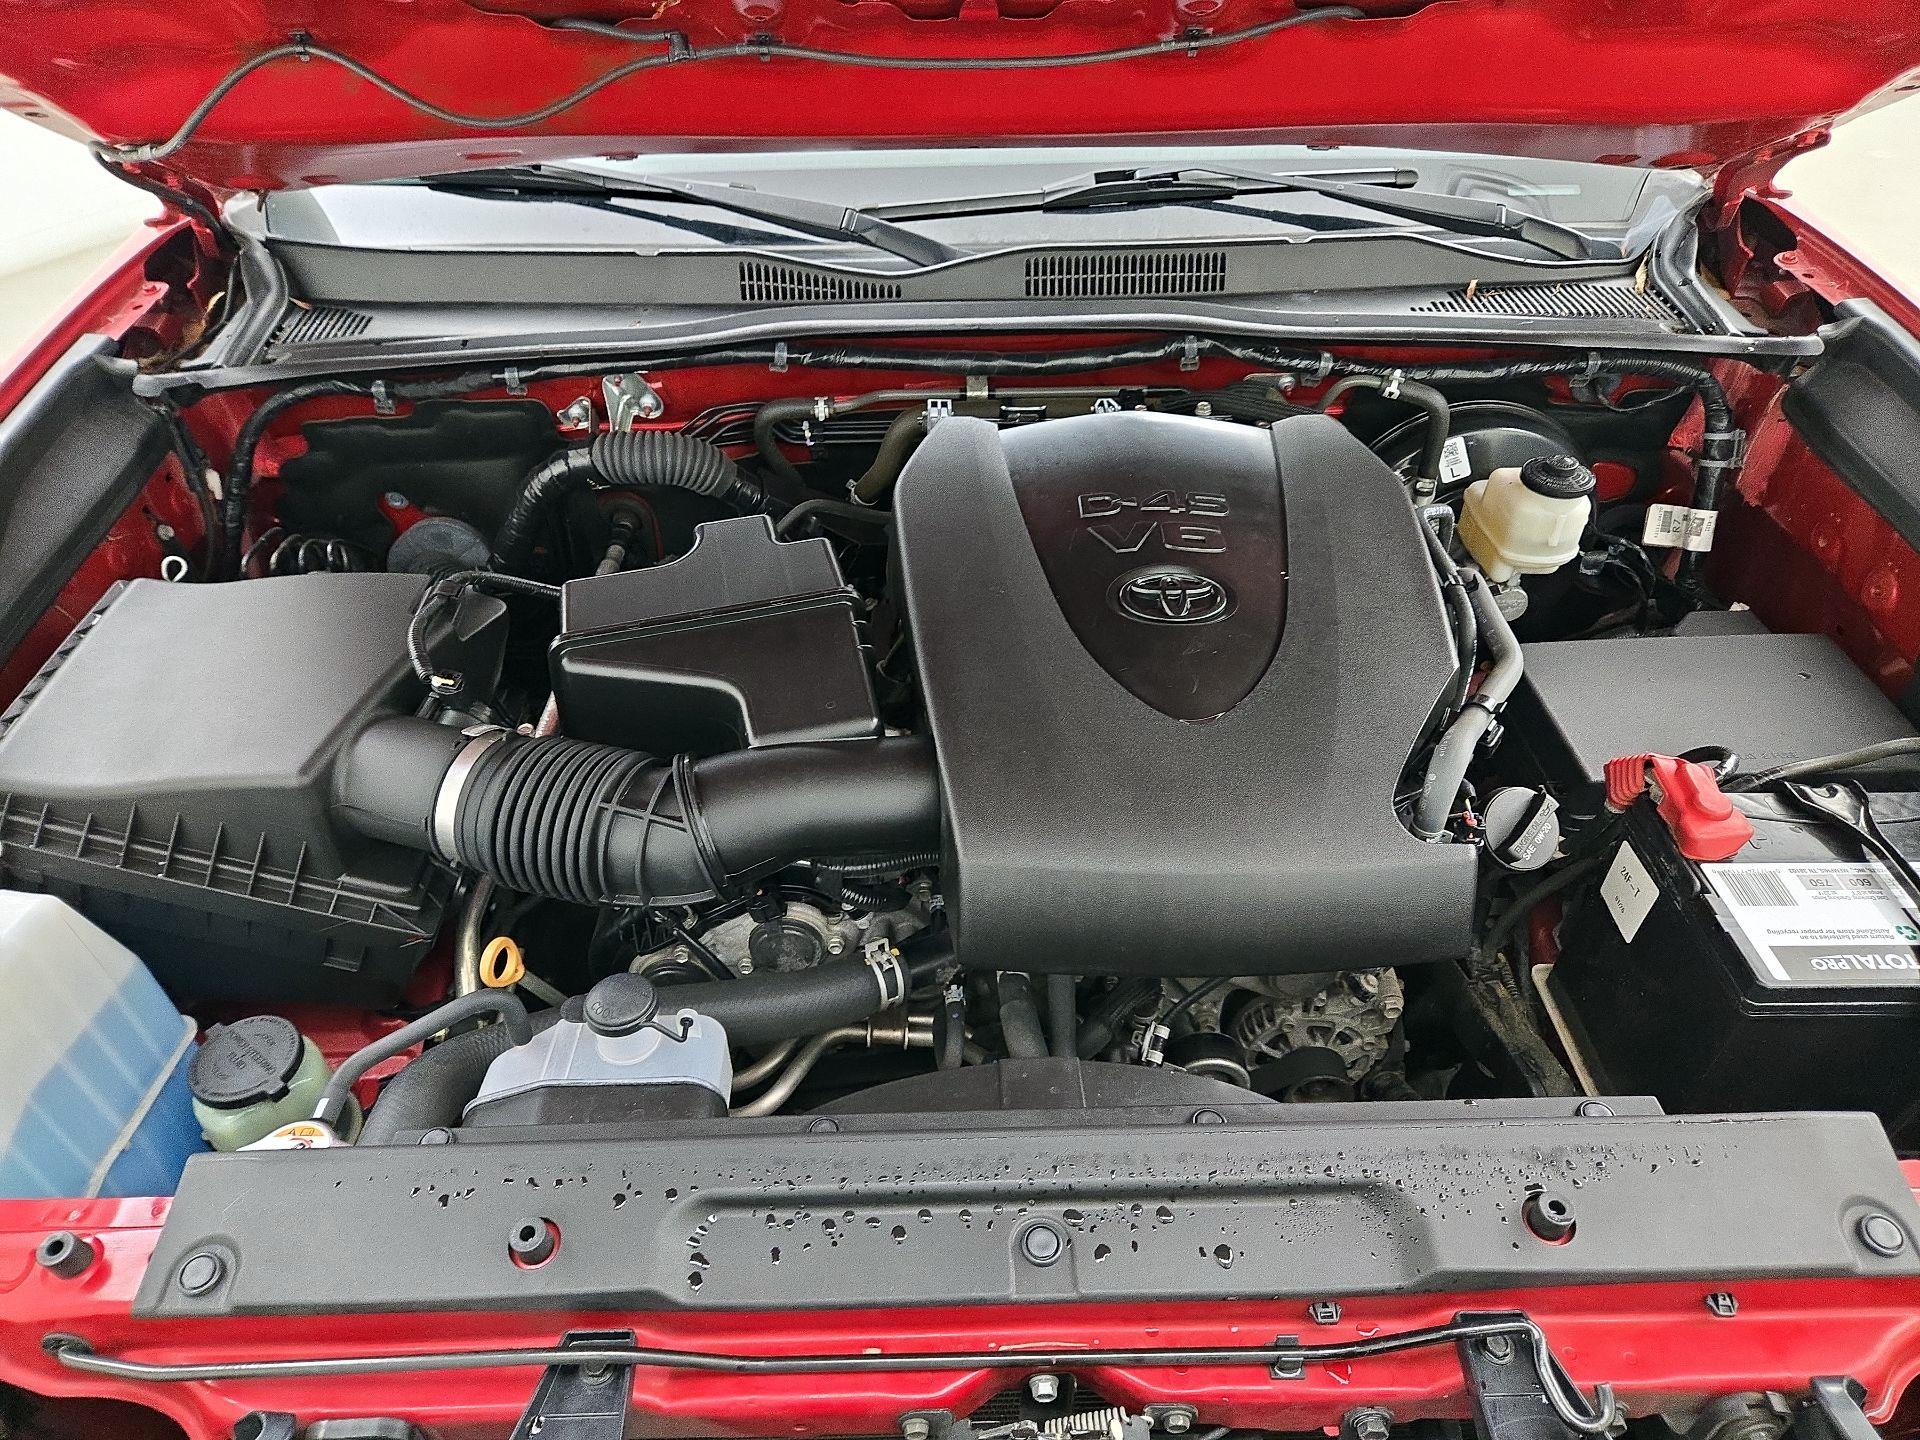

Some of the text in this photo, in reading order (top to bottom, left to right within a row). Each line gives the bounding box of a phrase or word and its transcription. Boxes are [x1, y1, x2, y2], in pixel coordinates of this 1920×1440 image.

[1077, 490, 1229, 519] D-4S
[1672, 519, 1681, 533] R7
[1086, 521, 1227, 554] V6
[1514, 828, 1535, 854] ENGINE
[1522, 822, 1552, 861] SAE 0W-20
[1809, 878, 1833, 887] 750
[1849, 878, 1872, 887] 600
[1809, 953, 1920, 971] TOTALPRO
